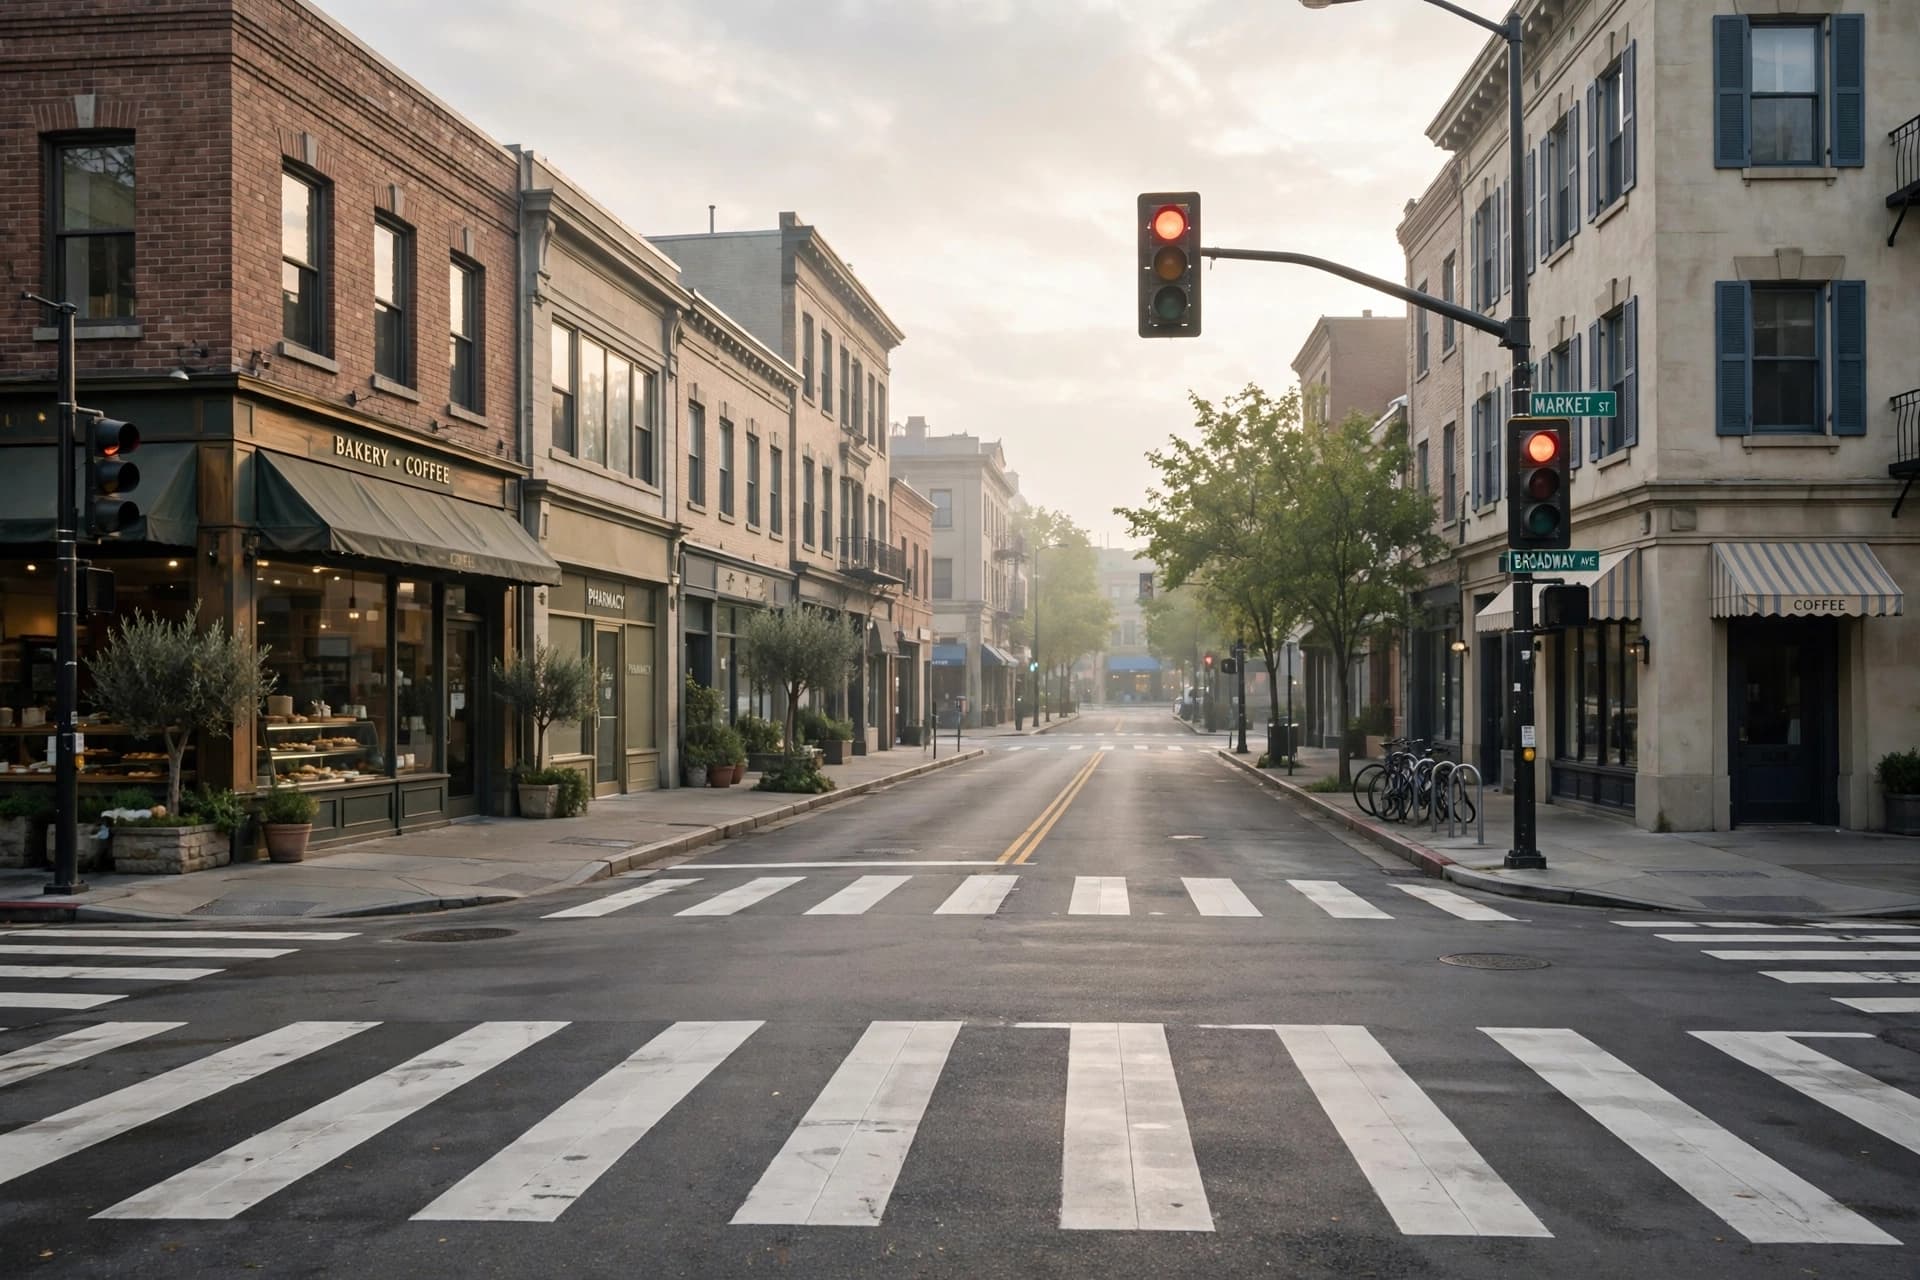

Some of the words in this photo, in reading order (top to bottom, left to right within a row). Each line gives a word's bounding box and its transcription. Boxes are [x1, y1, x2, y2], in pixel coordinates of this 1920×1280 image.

[1535, 396, 1591, 414] MARKET
[1598, 401, 1610, 413] ST
[335, 435, 389, 467] BAKERY
[405, 456, 450, 484] COFFEE
[1514, 552, 1576, 569] BROADWAY
[1580, 556, 1596, 566] AVE
[588, 588, 625, 610] PHARMACY
[1793, 599, 1846, 611] COFFEE
